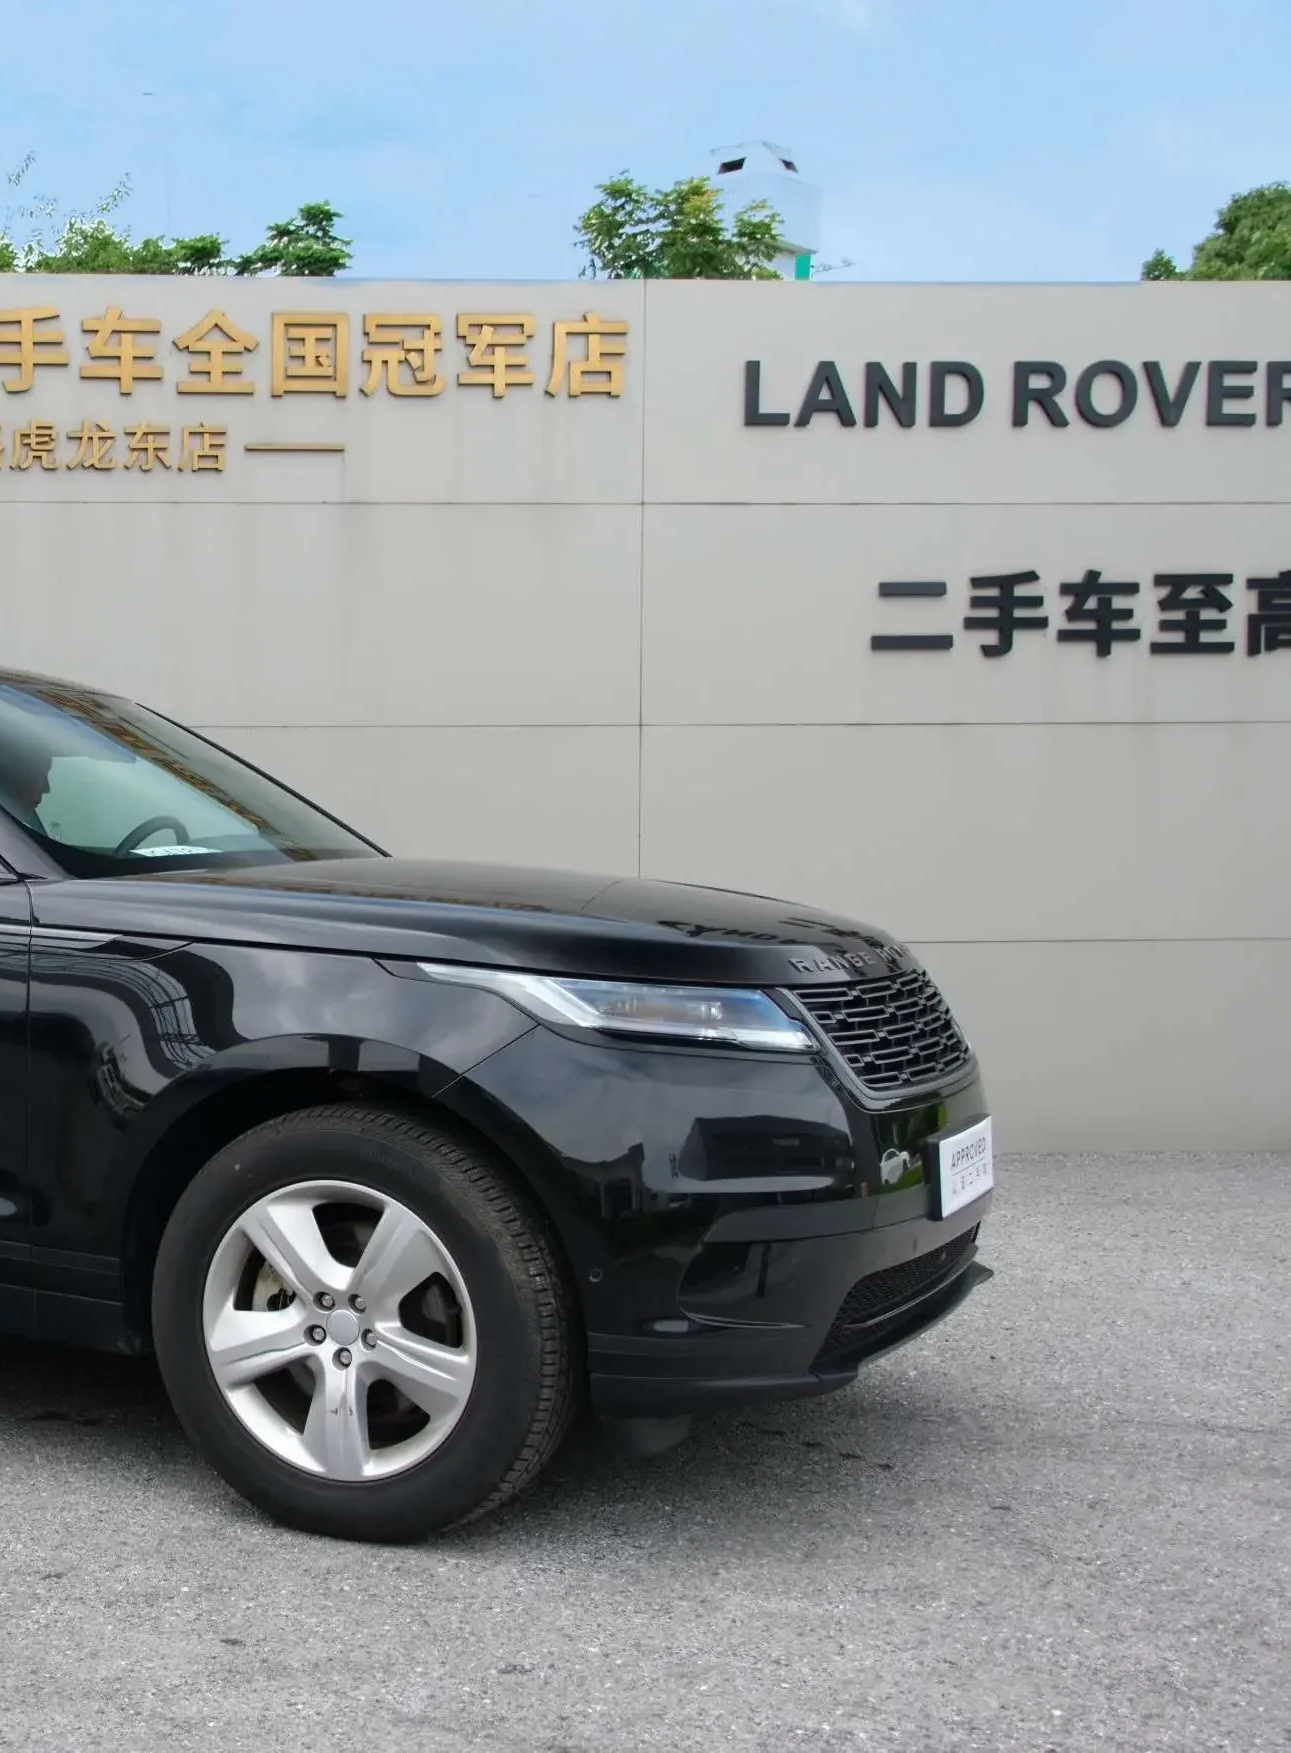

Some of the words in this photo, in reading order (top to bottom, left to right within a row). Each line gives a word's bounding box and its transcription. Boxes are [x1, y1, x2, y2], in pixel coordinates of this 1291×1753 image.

[743, 360, 985, 428] LAND
[789, 952, 875, 973] RANGE
[950, 1136, 988, 1170] APPROVED
